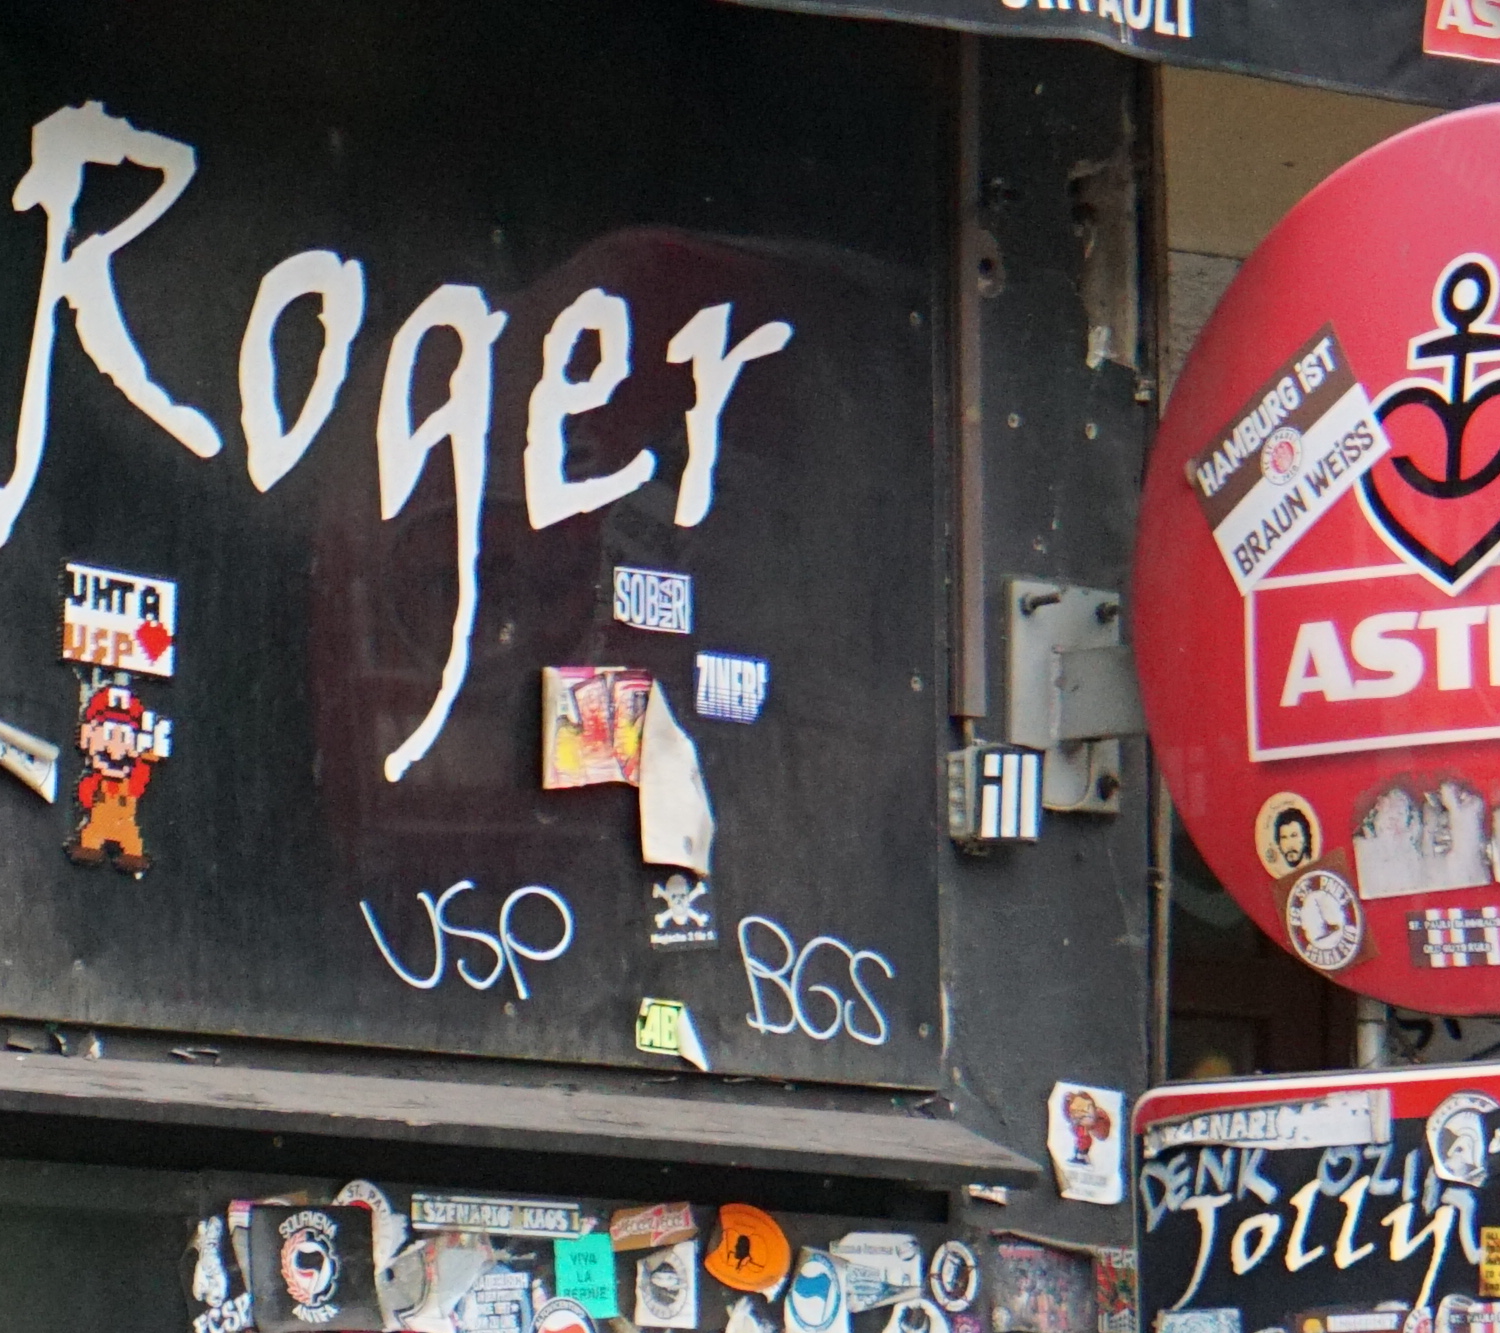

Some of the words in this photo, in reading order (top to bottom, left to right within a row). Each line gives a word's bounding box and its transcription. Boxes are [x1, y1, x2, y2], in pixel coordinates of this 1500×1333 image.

[1196, 382, 1302, 498] HAMBURG
[1232, 485, 1304, 578] BRAUN
[360, 880, 574, 999] USP
[522, 1207, 570, 1232] KAOS
[1172, 1173, 1460, 1309] Jolly
[576, 1271, 592, 1285] LA
